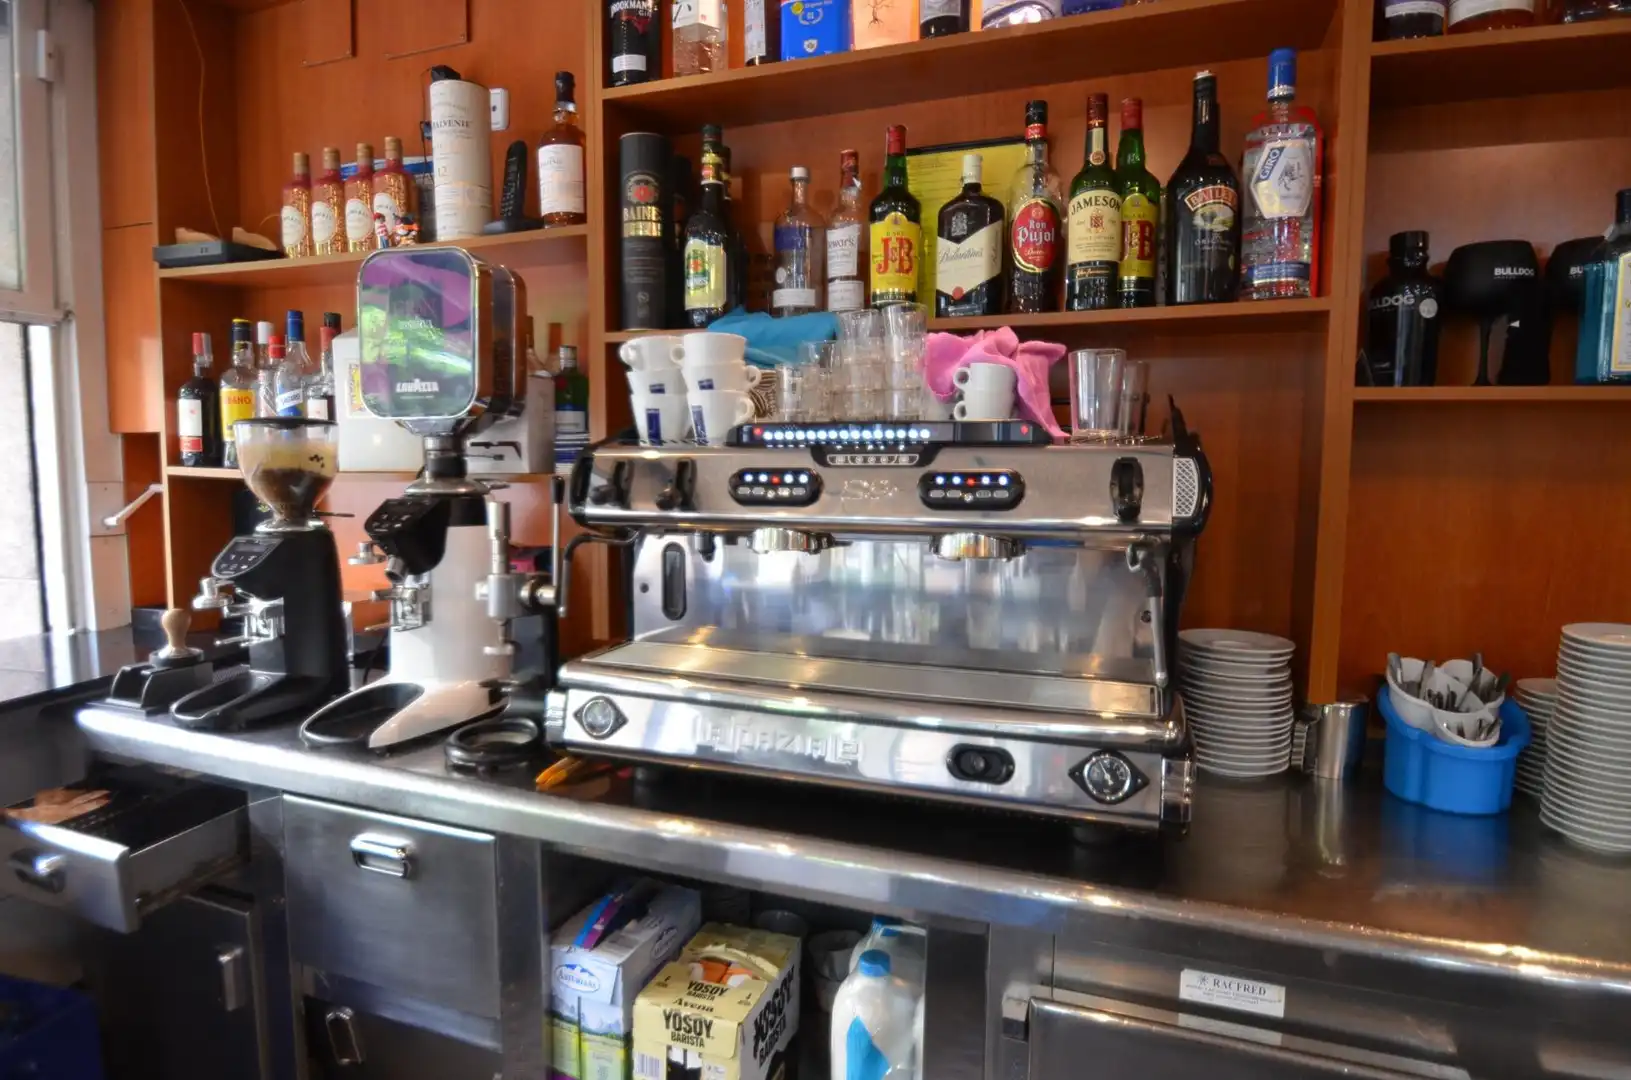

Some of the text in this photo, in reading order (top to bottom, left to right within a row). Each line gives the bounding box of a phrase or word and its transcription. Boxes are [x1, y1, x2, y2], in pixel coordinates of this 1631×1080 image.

[1071, 195, 1122, 215] JAMESON
[1029, 219, 1047, 229] Ron
[1017, 226, 1055, 247] Pujol
[1494, 266, 1535, 276] BULLDOG
[687, 981, 728, 996] YOSOY
[673, 998, 714, 1012] Avena
[663, 1009, 713, 1039] YOSOY
[671, 1031, 705, 1048] BARISTA
